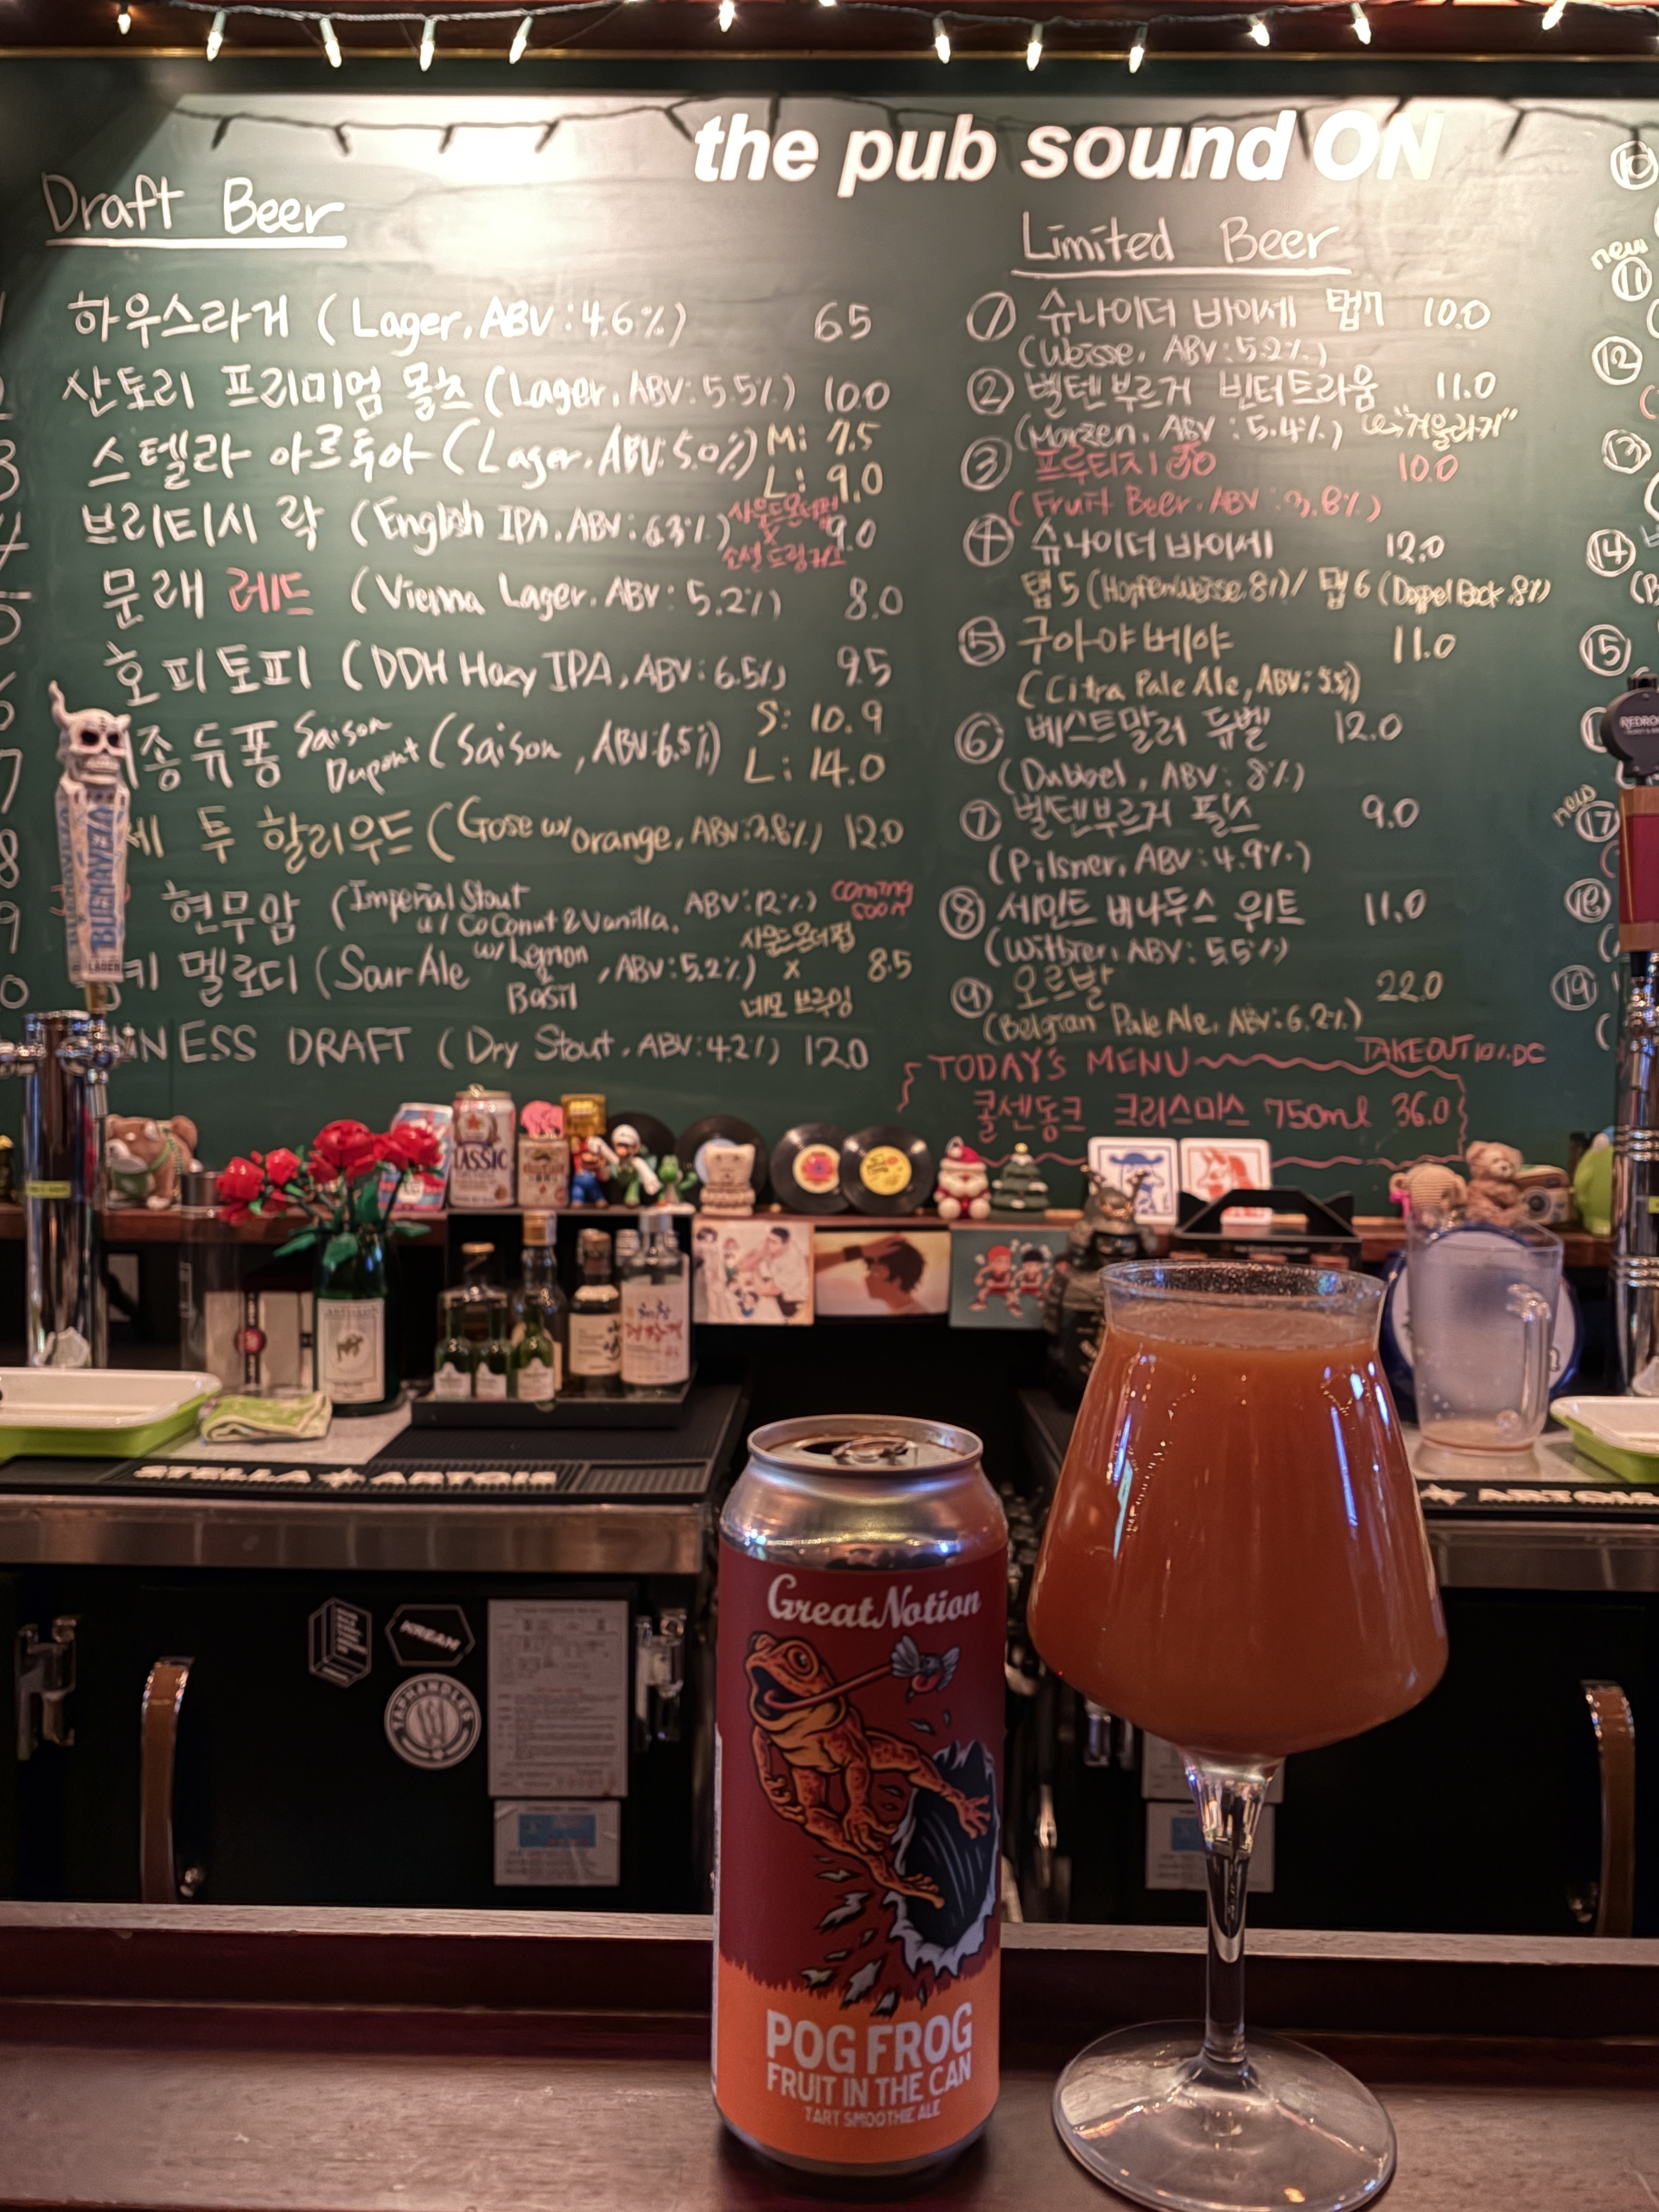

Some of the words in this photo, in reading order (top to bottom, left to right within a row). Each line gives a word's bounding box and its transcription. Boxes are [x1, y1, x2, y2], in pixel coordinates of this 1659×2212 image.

[693, 113, 818, 182] the
[837, 113, 997, 198] pub
[1020, 110, 1296, 182] sound
[1313, 110, 1444, 182] ON
[42, 173, 184, 232] Draft
[223, 177, 345, 234] Beer
[1022, 211, 1175, 263] Limited
[1220, 216, 1340, 263] Beer
[1591, 239, 1649, 270] new
[67, 291, 289, 348] 하우스라거
[1037, 288, 1176, 336] 슈나이더
[1424, 298, 1491, 330] 10.0
[61, 366, 194, 417] 산토리
[221, 366, 382, 422] 프리미엄
[1437, 371, 1497, 400] 11.0
[88, 430, 251, 489] 스텔라
[270, 424, 436, 483] 아르투아
[826, 417, 881, 455] 7.5
[1400, 452, 1459, 483] 10.0
[826, 461, 883, 503] 9.0
[81, 500, 257, 548] 브리티시
[275, 494, 325, 551] 락
[825, 514, 877, 551] 9.0
[1031, 517, 1155, 566] 슈나이더
[1386, 530, 1445, 564] 12.0
[102, 567, 205, 630] 문래
[225, 566, 314, 617] 레드
[844, 576, 904, 620] 8.0
[1393, 625, 1457, 663] 11.0
[103, 641, 313, 707] 호피토피
[460, 649, 537, 698] Hazy
[1135, 668, 1185, 698] Pale
[810, 699, 883, 735] 10.9
[1335, 710, 1403, 743] 12.0
[190, 720, 281, 789] 듀퐁
[294, 709, 393, 759] Saison
[326, 735, 421, 795] Dupont
[810, 747, 886, 788] 14.0
[1361, 794, 1420, 829] 9.0
[256, 805, 414, 875] 할리우드
[161, 879, 300, 945] 현무암
[460, 879, 531, 913] Stout
[997, 888, 1097, 929] 세인트
[1234, 888, 1306, 933] 위트
[1365, 889, 1425, 927] 11.0
[178, 946, 298, 1007] 멜로디
[418, 943, 470, 990] Ale
[509, 935, 589, 969] Lemon
[867, 947, 912, 983] 8.5
[1013, 964, 1115, 1012] 오르발
[1376, 969, 1443, 1003] 22.0
[506, 981, 578, 1015] Basil
[1110, 1002, 1161, 1037] Pale
[288, 1026, 411, 1067] DRAFT
[1086, 1045, 1190, 1077] MENU
[974, 1090, 1085, 1144] 콜센동크
[1115, 1091, 1250, 1128] 크리스마스
[1265, 1096, 1372, 1130] 750ml
[1391, 1090, 1449, 1128] 36.0
[768, 1573, 878, 1628] Great
[877, 1585, 981, 1629] Notion
[766, 2009, 856, 2074] POG
[867, 2002, 972, 2074] FROG
[768, 2061, 836, 2106] FRUIT
[843, 2078, 868, 2107] IN
[875, 2072, 923, 2106] THE
[929, 2052, 971, 2096] CAN
[805, 2106, 839, 2127] TART
[844, 2104, 915, 2128] SMOOTHIE
[918, 2100, 940, 2120] ALE
